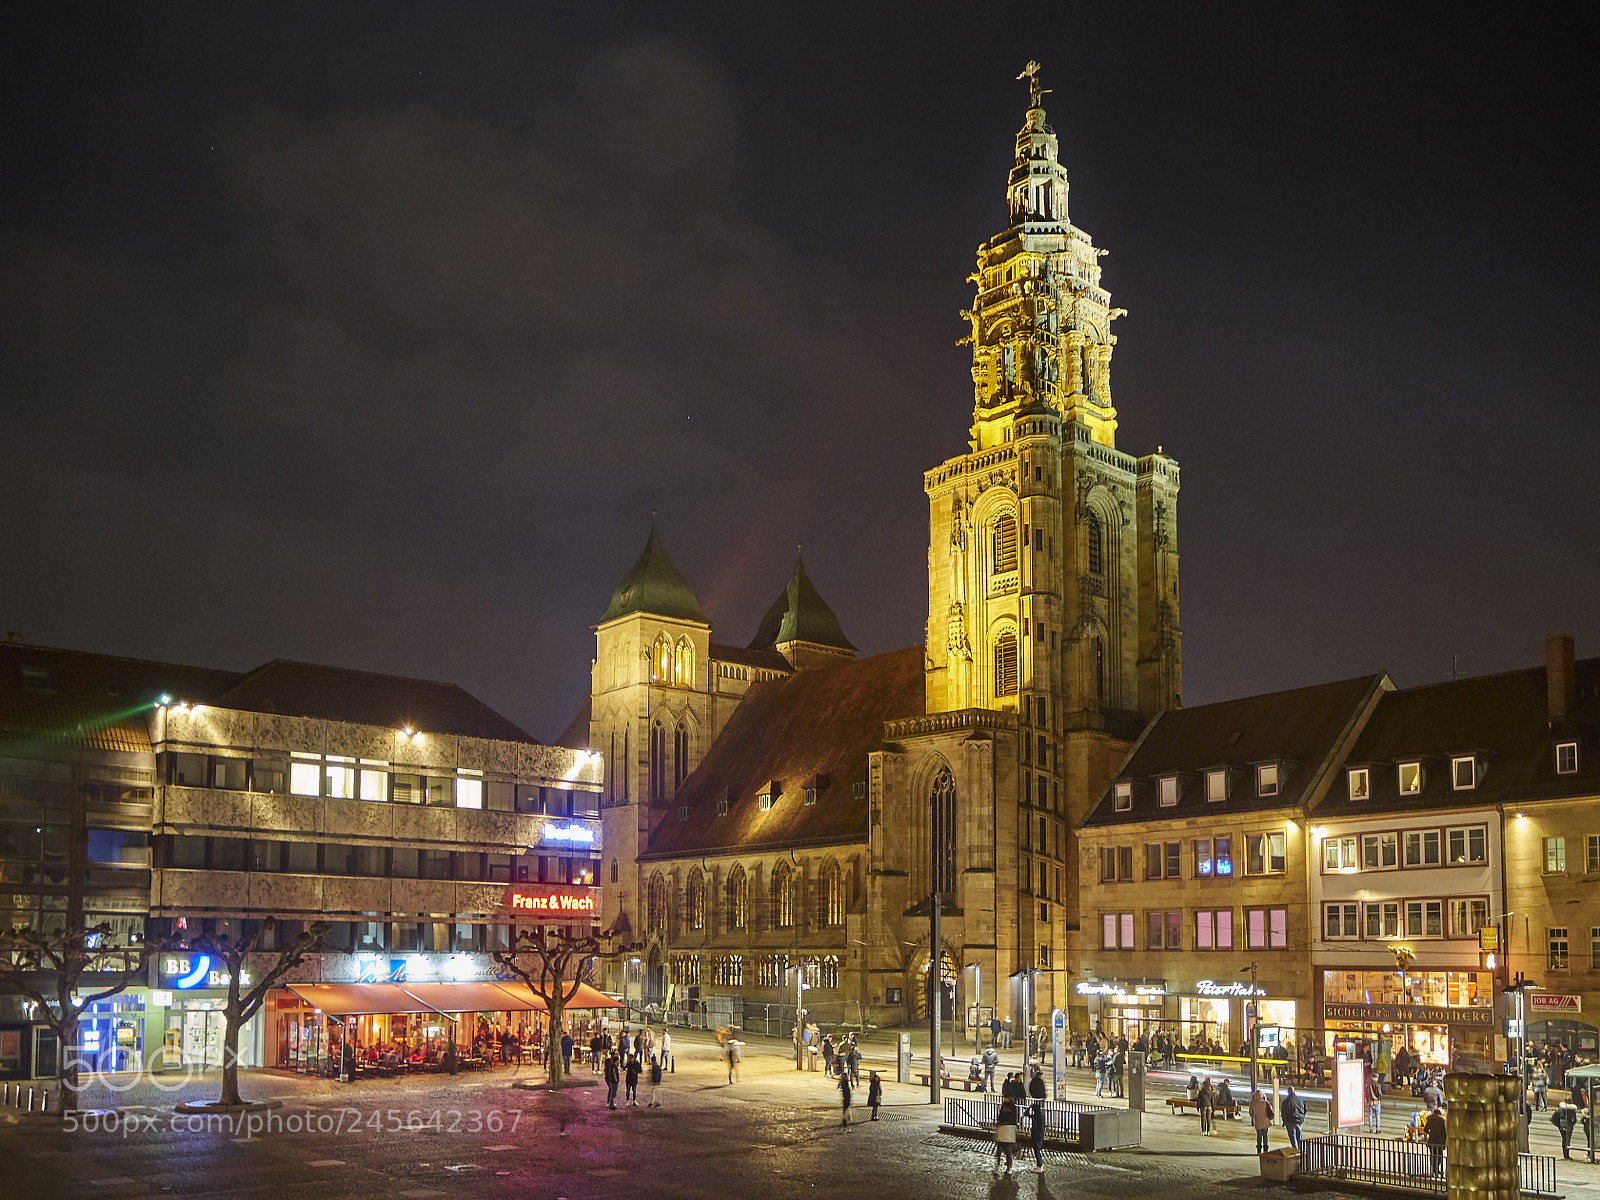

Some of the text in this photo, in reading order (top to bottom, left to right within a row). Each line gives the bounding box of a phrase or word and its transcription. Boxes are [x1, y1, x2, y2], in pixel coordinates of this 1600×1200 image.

[512, 894, 594, 910] Franz & Wach
[166, 958, 191, 975] BB
[208, 969, 252, 986] Bak
[1548, 997, 1559, 1005] AG
[1418, 1009, 1490, 1023] APOTHEKE
